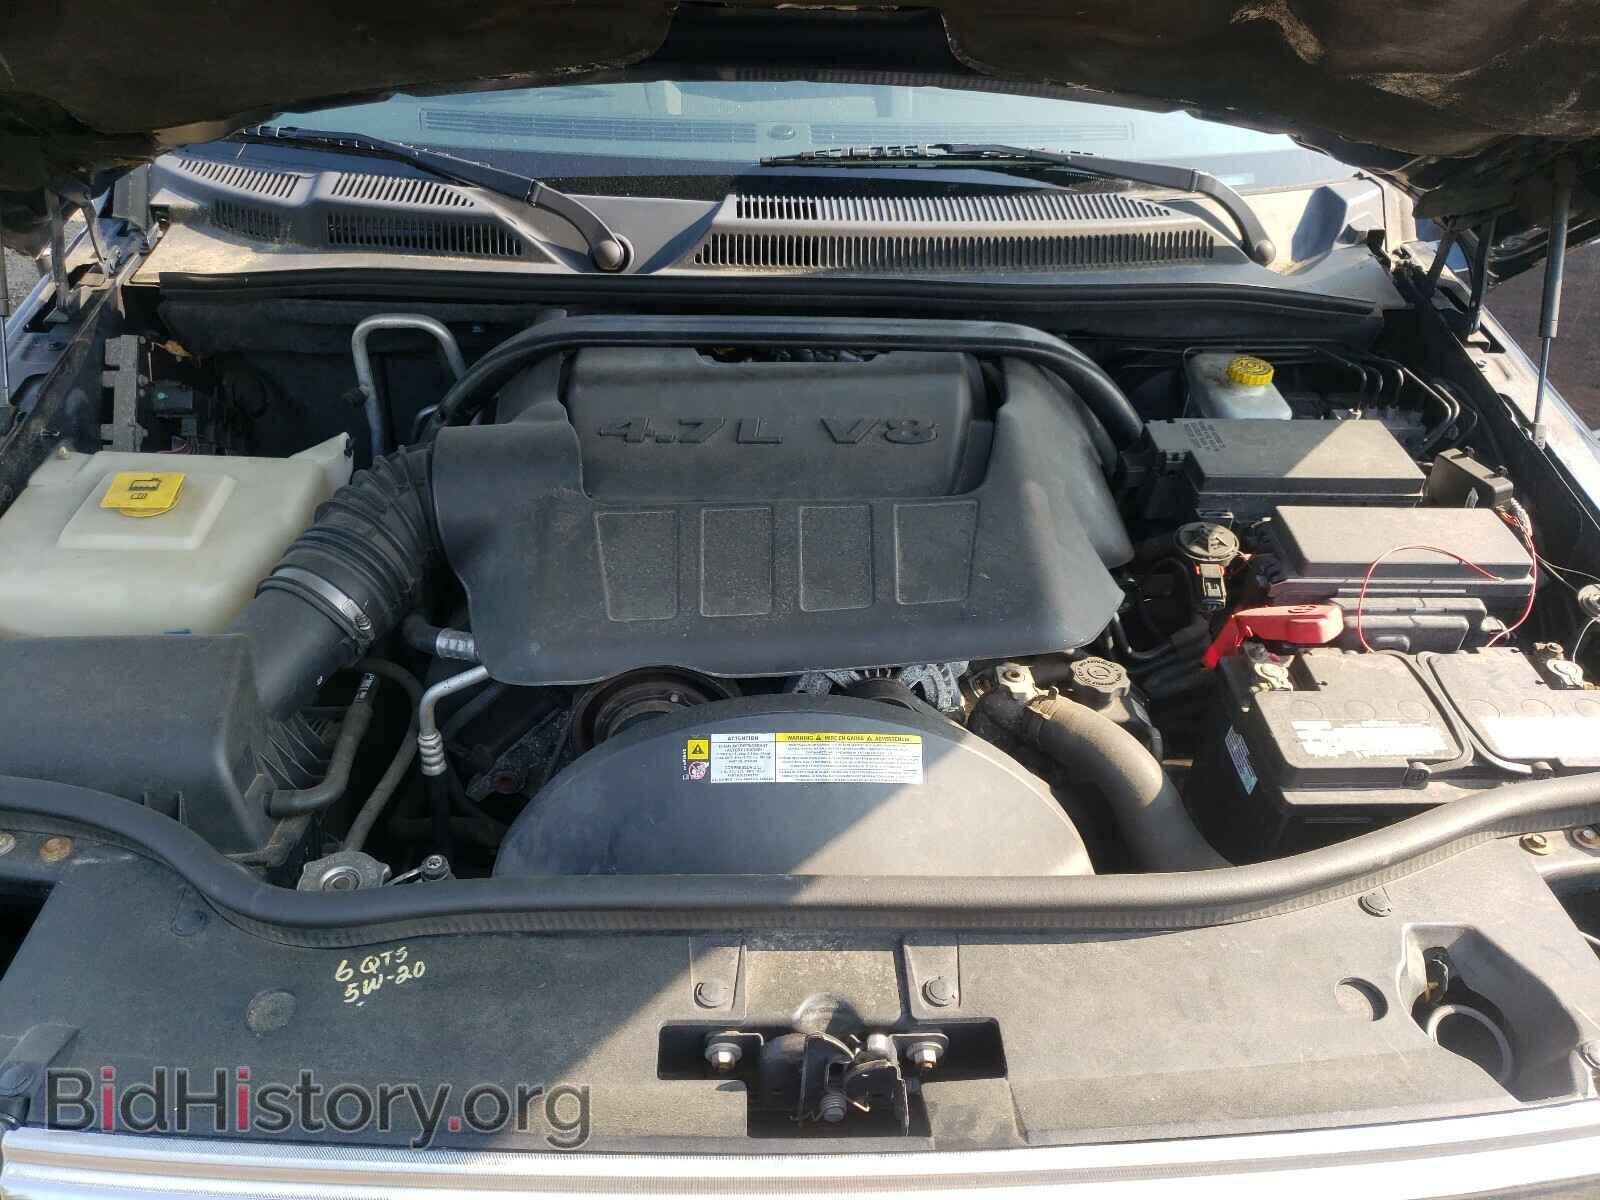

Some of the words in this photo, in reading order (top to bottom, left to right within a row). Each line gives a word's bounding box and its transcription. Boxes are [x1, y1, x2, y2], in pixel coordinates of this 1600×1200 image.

[598, 415, 784, 445] 4.7L
[820, 415, 940, 446] V8
[335, 959, 354, 982] 6
[360, 946, 408, 974] QTS
[343, 960, 426, 1003] 5W-20
